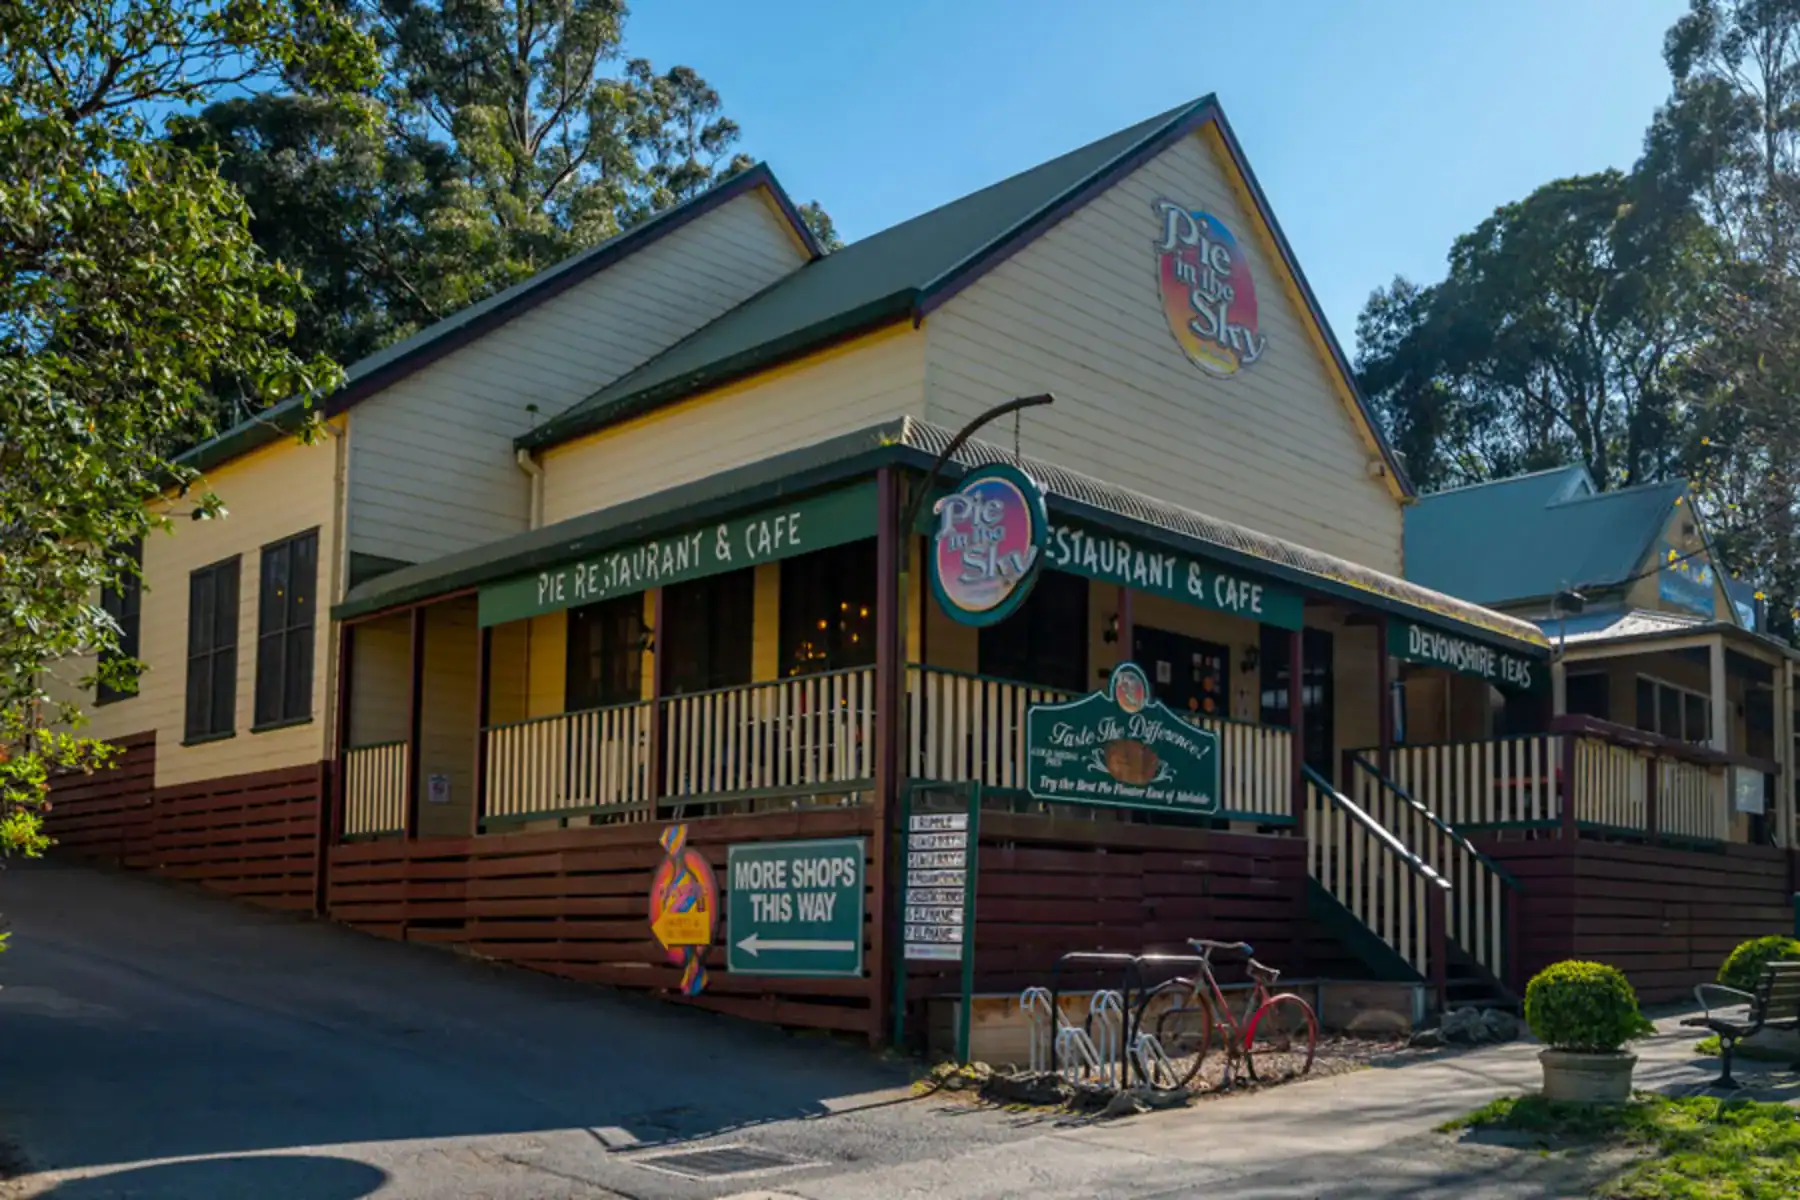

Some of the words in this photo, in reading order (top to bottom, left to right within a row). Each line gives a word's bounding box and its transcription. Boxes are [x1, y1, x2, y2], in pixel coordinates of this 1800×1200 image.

[1152, 198, 1232, 277] Pie
[1174, 250, 1198, 286] in
[1201, 266, 1236, 303] the
[1187, 290, 1268, 366] Sky
[932, 489, 1004, 541] Pie
[948, 533, 967, 552] in
[972, 522, 1005, 546] the
[537, 572, 566, 606] PIE
[715, 524, 732, 562] &
[745, 511, 801, 560] CAFE
[958, 543, 1038, 586] Sky
[1046, 525, 1178, 590] ESTAURANT
[1186, 560, 1204, 600] &
[1214, 574, 1264, 614] CAFE
[1408, 624, 1497, 678] DEVONSHIRE
[1500, 653, 1532, 689] TEAS
[1048, 722, 1094, 748] Taste
[1095, 716, 1125, 743] The
[734, 860, 788, 891] MORE
[791, 856, 857, 889] SHOPS
[750, 891, 793, 923] THIS
[796, 890, 837, 923] WAY
